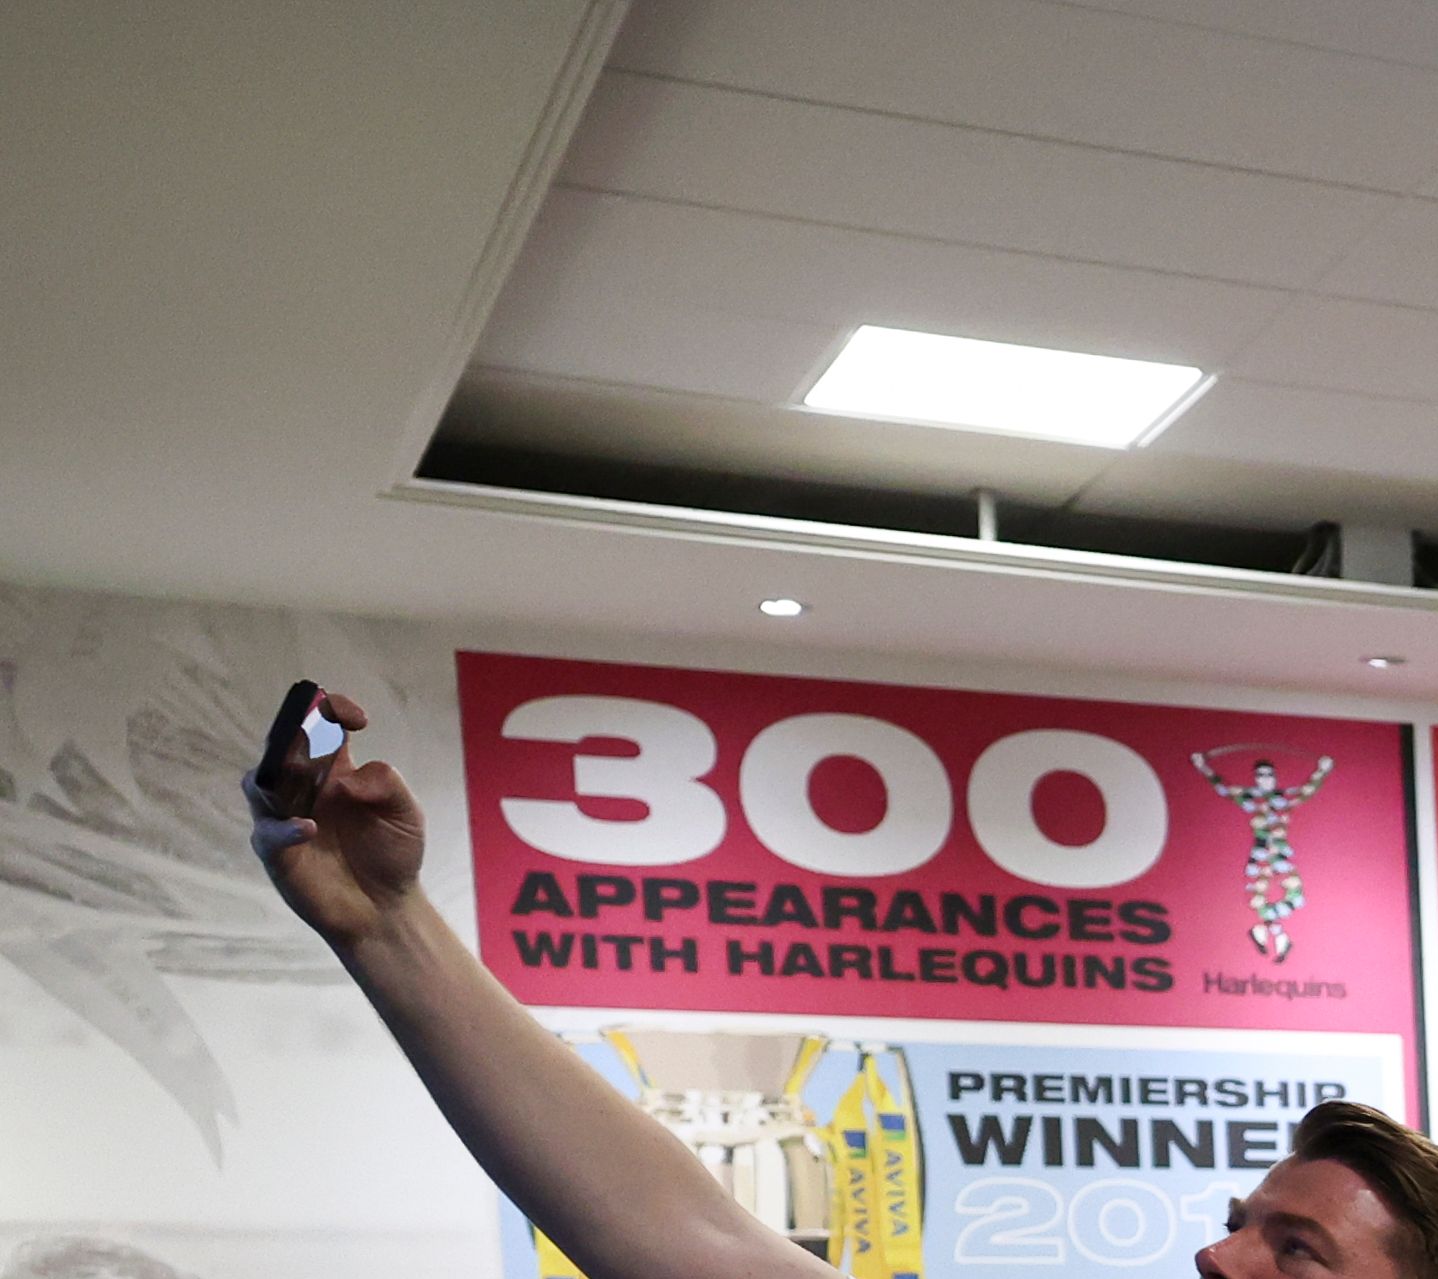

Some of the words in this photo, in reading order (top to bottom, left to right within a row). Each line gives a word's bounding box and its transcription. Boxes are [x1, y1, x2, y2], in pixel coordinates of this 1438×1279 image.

[499, 693, 1170, 890] 300
[511, 870, 1174, 945] APPEARANCES
[512, 928, 700, 976] WITH
[727, 939, 1174, 994] HARLEQUINS
[1202, 970, 1348, 1001] Harlequins
[946, 1070, 1347, 1109] PREMIERSHIP
[946, 1112, 1300, 1170] WINNE
[847, 1166, 872, 1255] AVIVA
[884, 1150, 910, 1237] AVIVA
